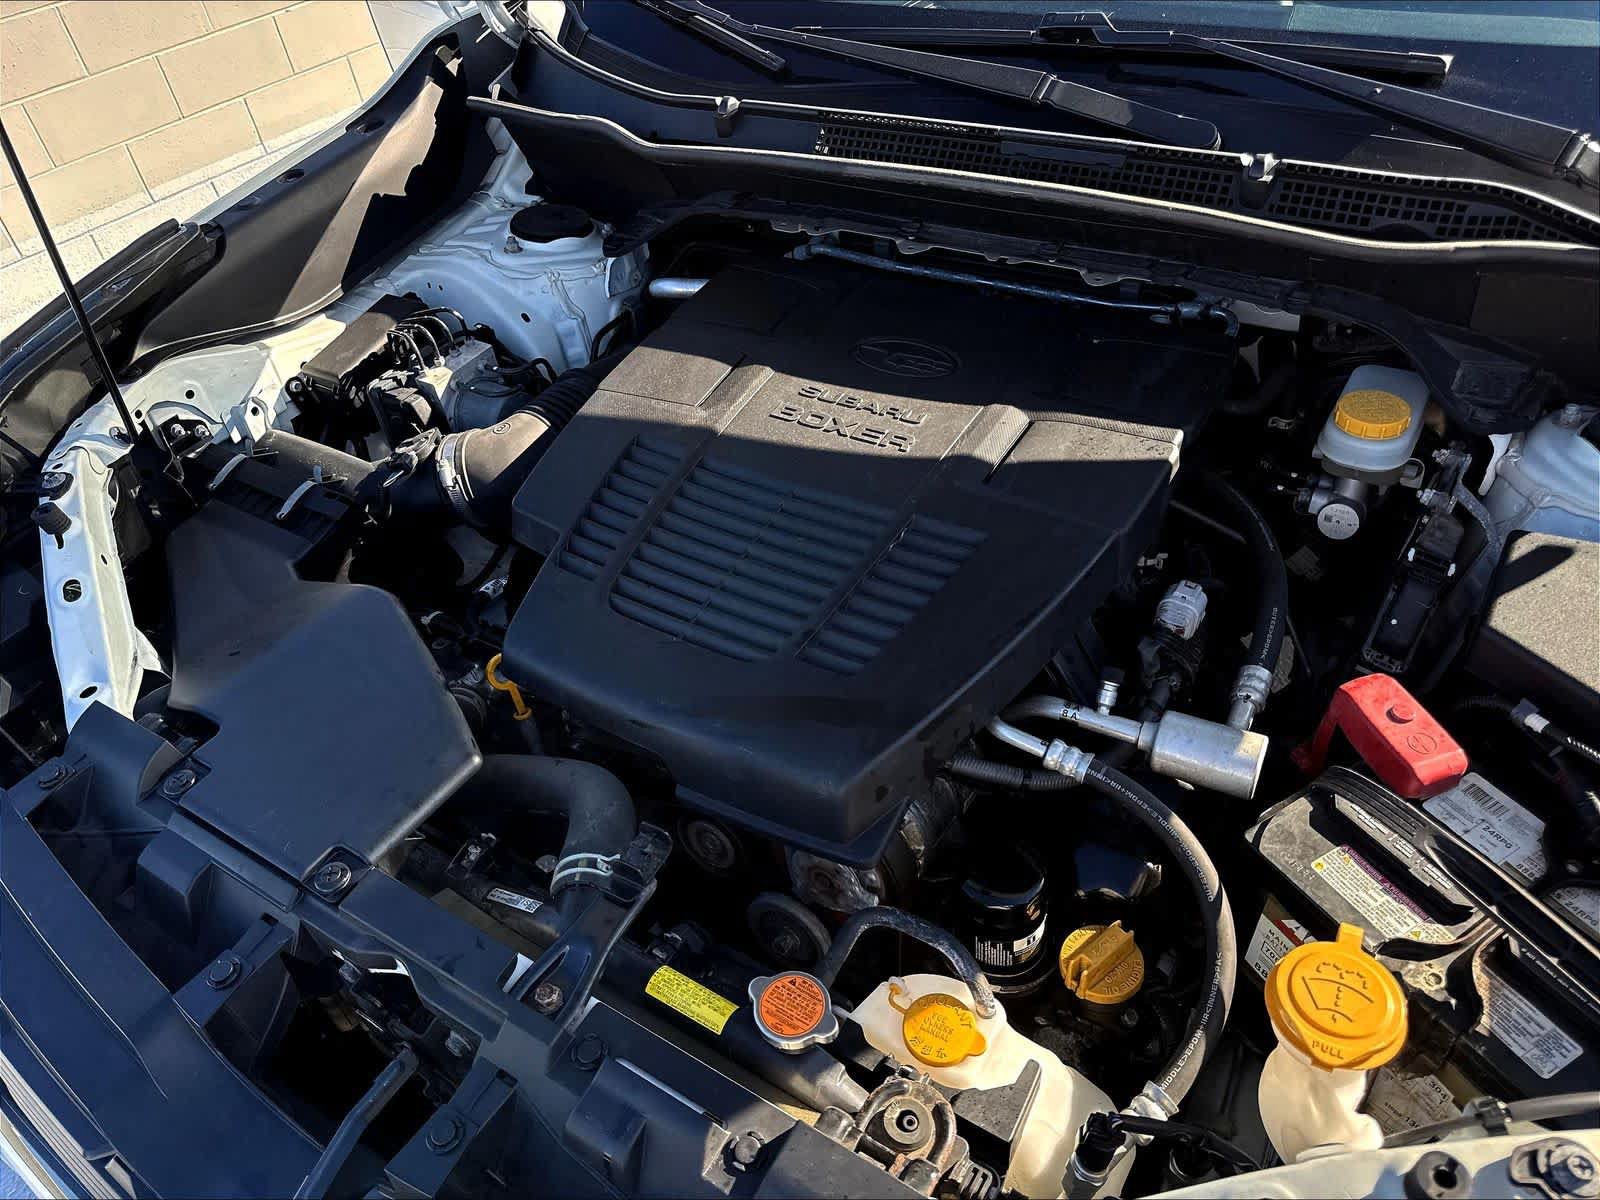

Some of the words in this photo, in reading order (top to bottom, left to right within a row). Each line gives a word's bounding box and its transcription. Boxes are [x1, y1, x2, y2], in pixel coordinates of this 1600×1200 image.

[798, 386, 928, 425] SUBARU
[768, 402, 916, 453] BOXER
[1311, 1039, 1345, 1060] PULL
